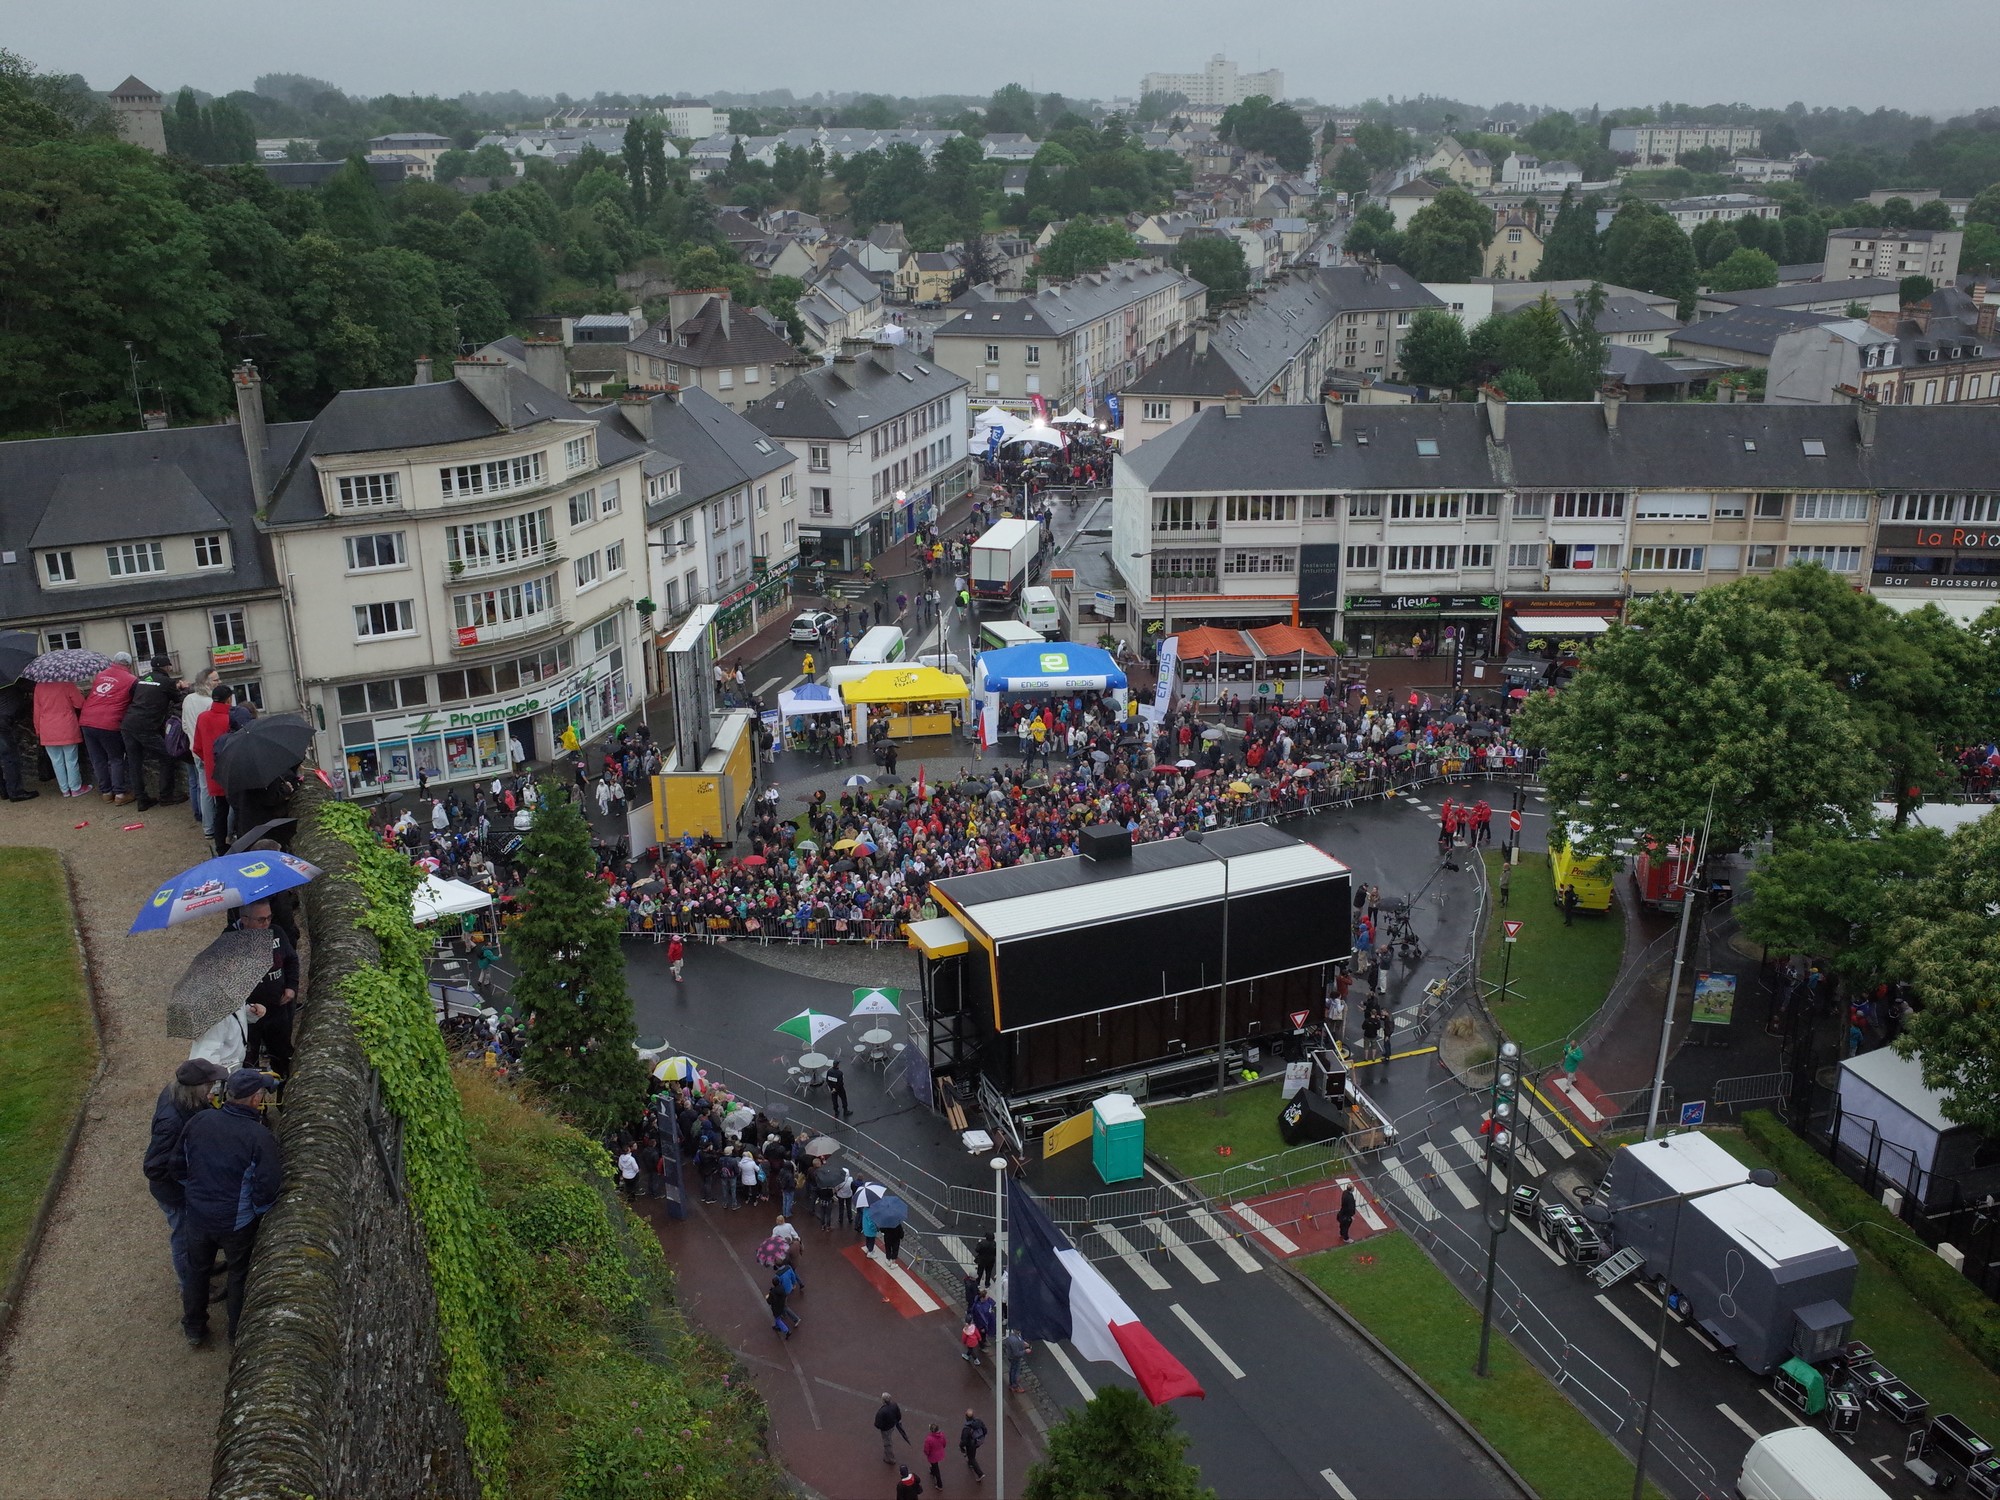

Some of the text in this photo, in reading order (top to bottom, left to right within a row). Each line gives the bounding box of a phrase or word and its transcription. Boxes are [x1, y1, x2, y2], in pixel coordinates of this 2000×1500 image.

[1917, 528, 1942, 546] La
[1885, 576, 1998, 588] Bar Brasserie
[1397, 596, 1429, 610] fleur
[449, 698, 540, 727] Pharmacie
